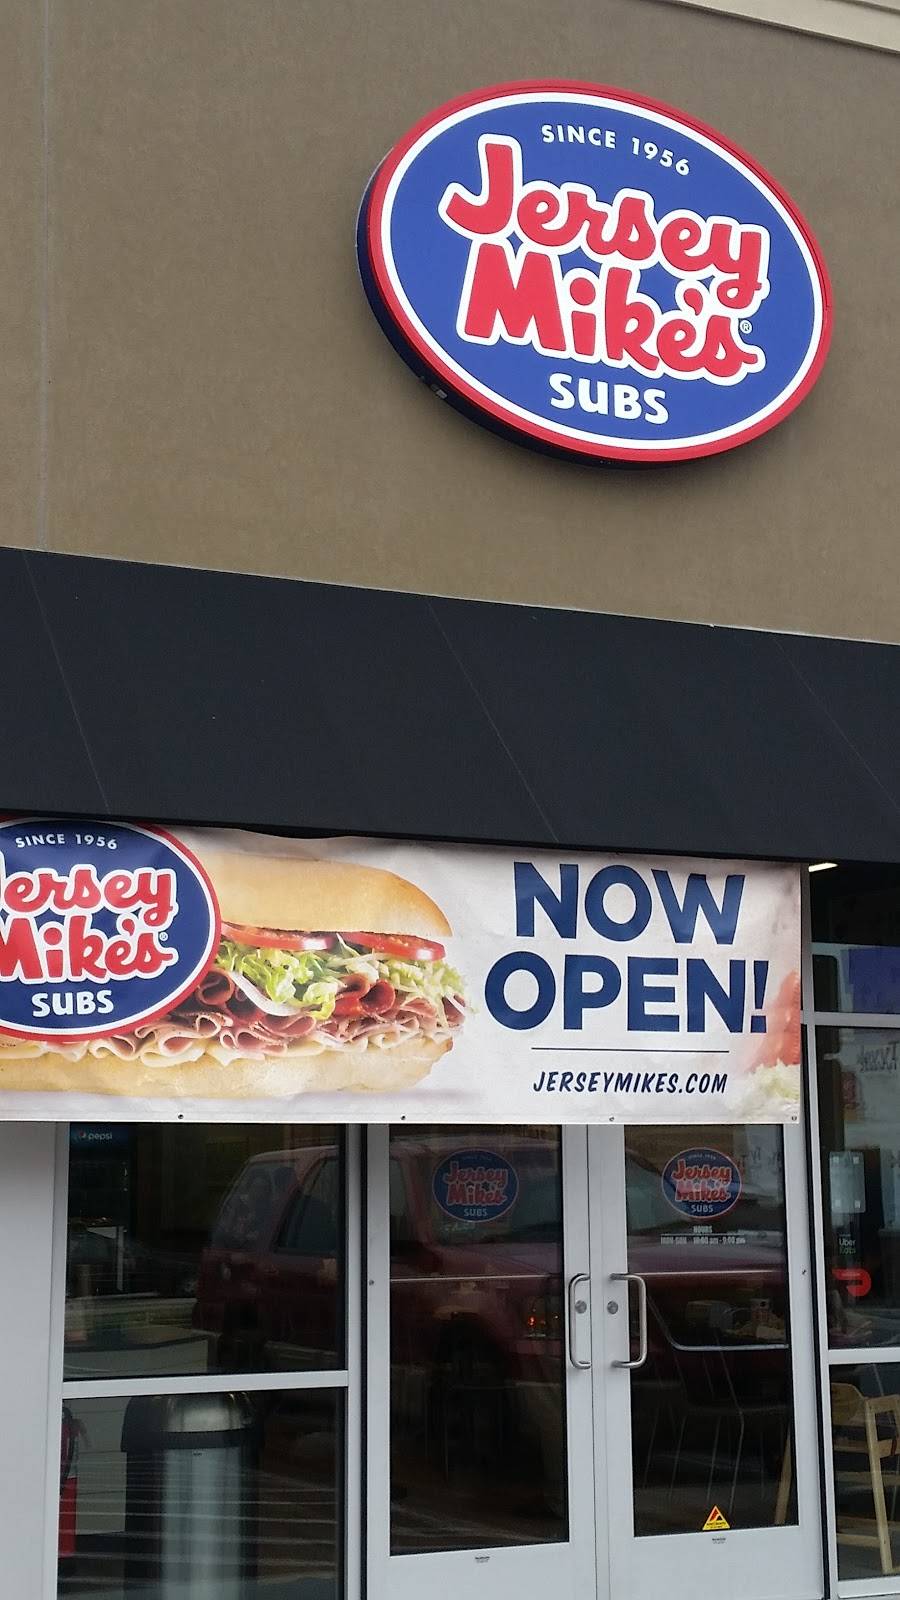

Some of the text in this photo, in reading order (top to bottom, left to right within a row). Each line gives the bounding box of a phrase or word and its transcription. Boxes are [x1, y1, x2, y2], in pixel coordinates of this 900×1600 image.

[541, 123, 691, 176] SINCE 1956
[438, 133, 770, 314] Jersey
[457, 239, 766, 386] Mike's
[548, 372, 669, 424] SUBS
[15, 833, 118, 850] SINCE 1956
[0, 852, 179, 931] ersey
[513, 861, 746, 945] NOW
[31, 989, 115, 1017] SUBS
[484, 950, 770, 1034] OPEN!
[533, 1071, 728, 1094] JERSEYMIKES.COM
[88, 1131, 113, 1142] pepsi
[442, 1160, 508, 1190] Jersey
[671, 1158, 732, 1187] Jersey
[690, 1204, 714, 1213] SUBS
[839, 1238, 856, 1246] Uber
